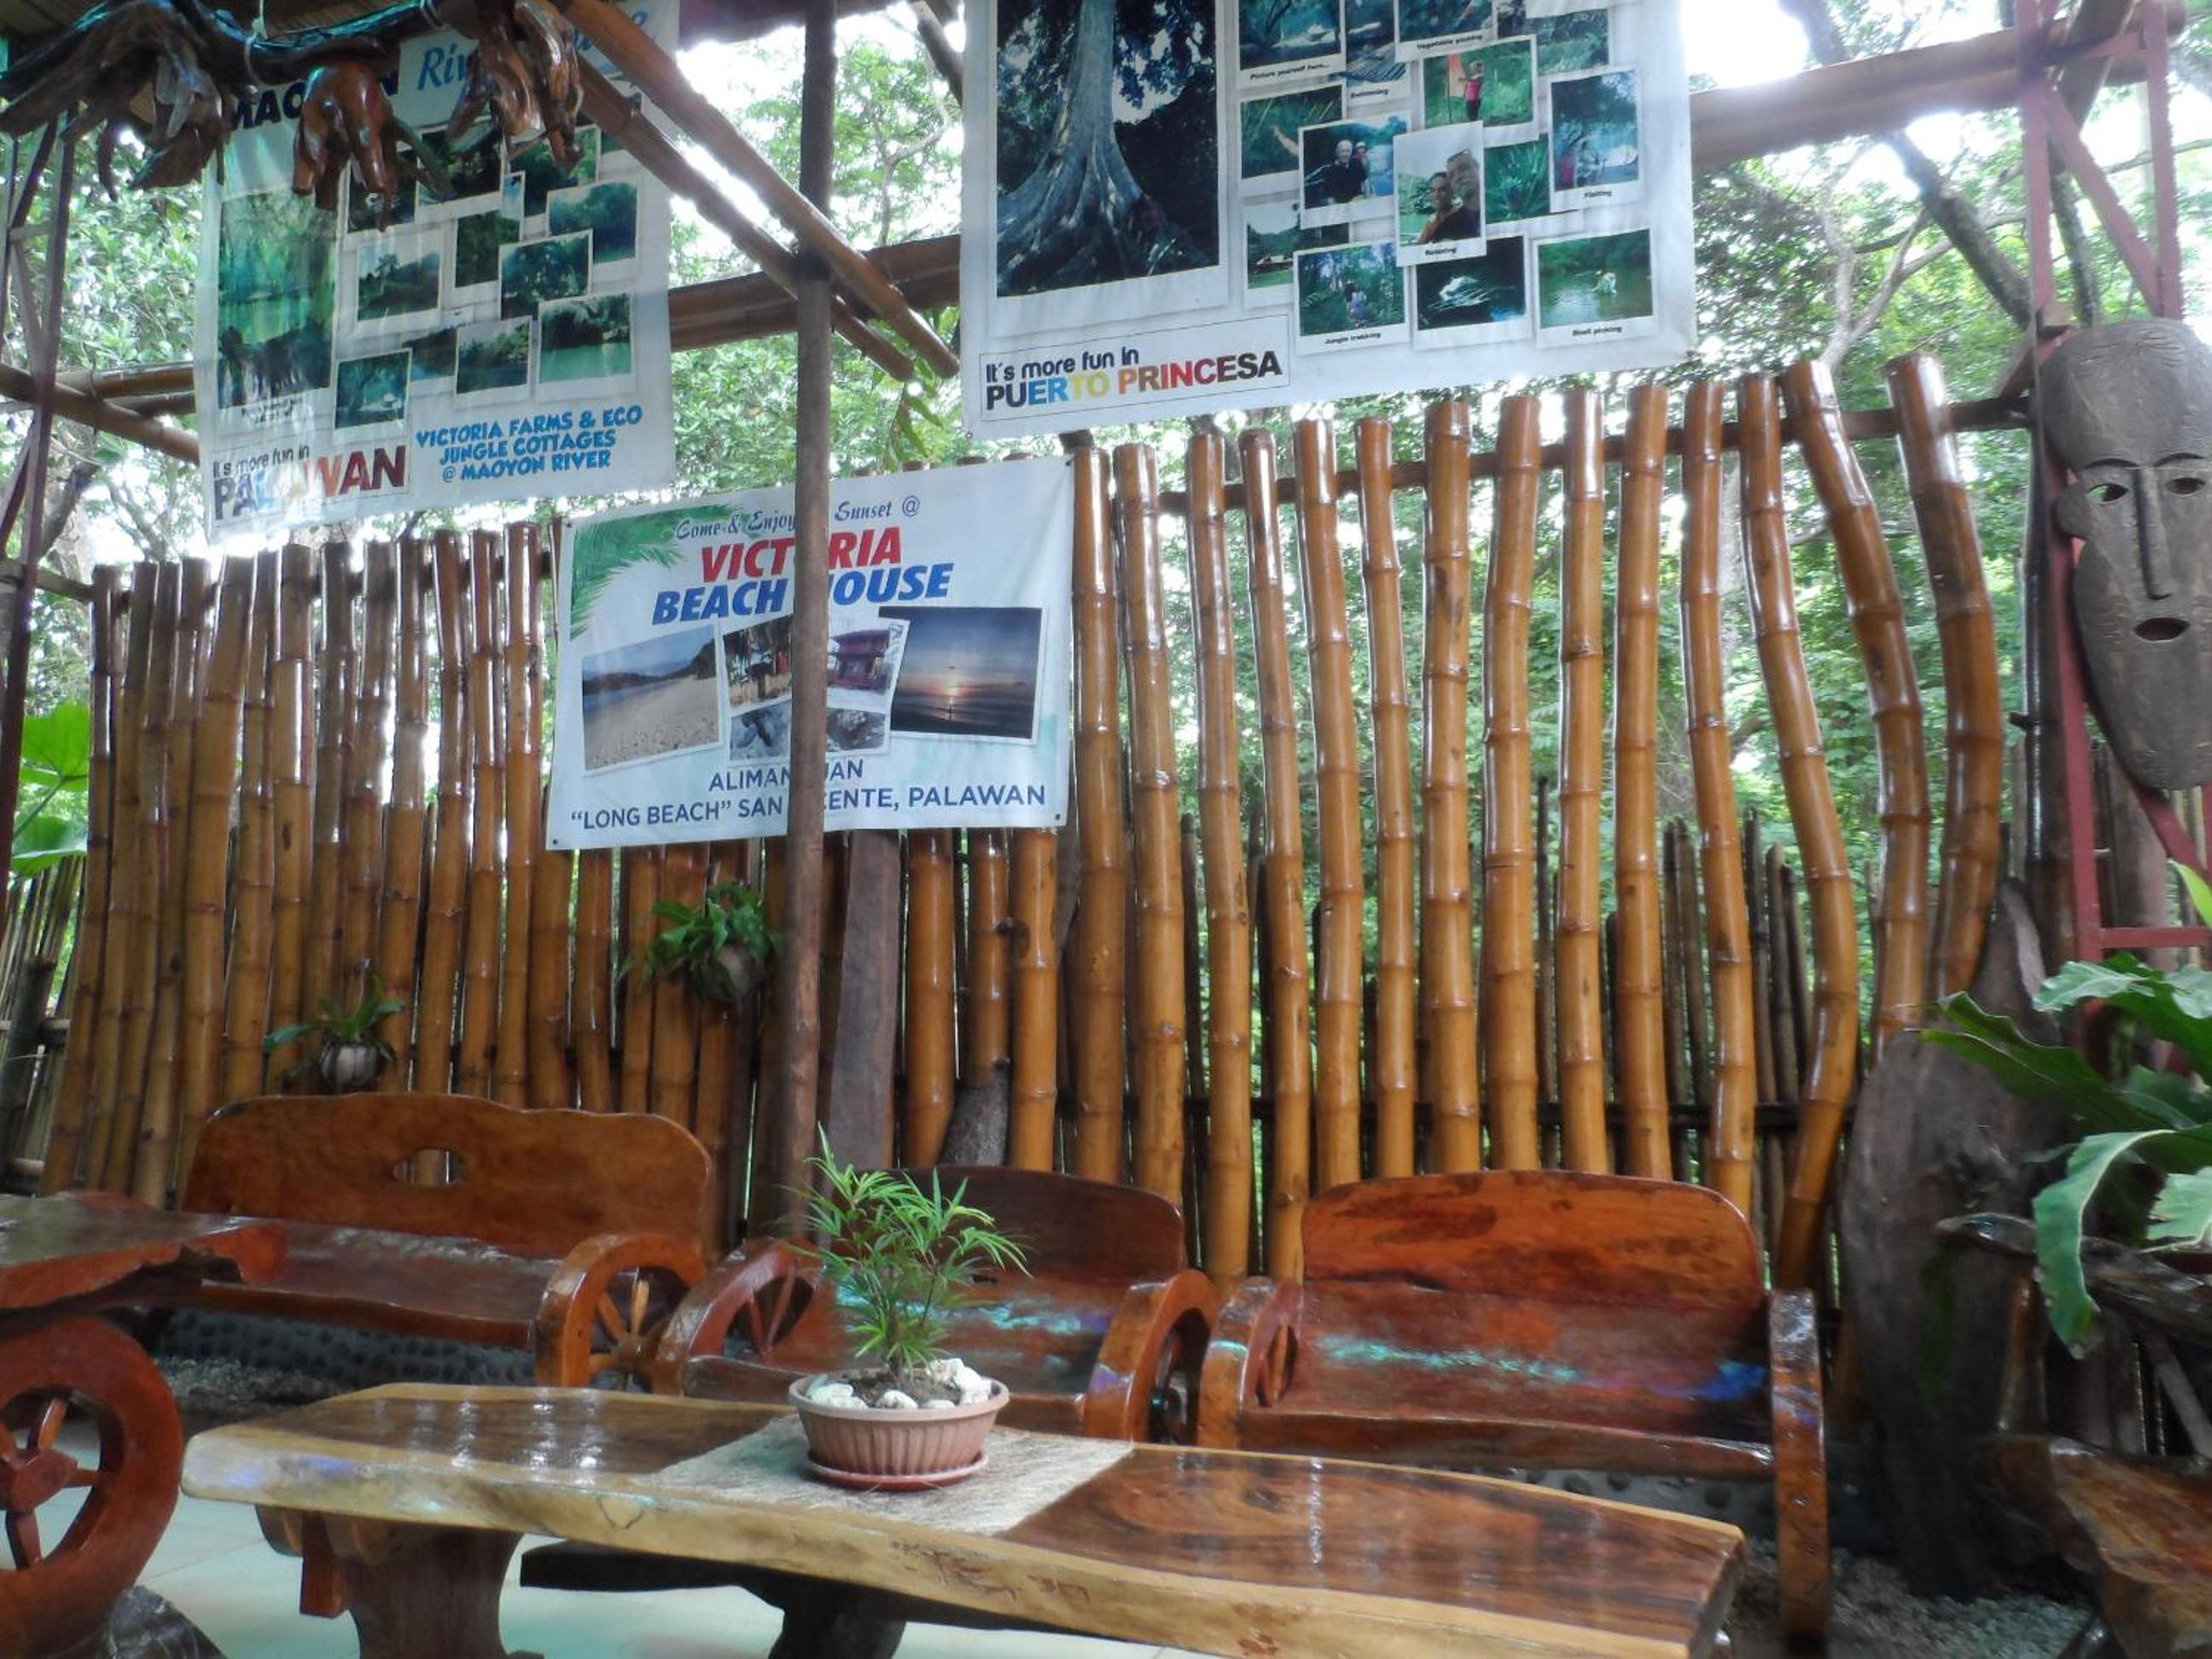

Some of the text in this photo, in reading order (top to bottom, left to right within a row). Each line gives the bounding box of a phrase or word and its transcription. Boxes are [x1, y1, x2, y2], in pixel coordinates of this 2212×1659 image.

[986, 351, 1284, 410] PUERTO PRINCESA
[1022, 356, 1076, 381] more
[1081, 350, 1115, 371] fun
[1121, 345, 1140, 367] in
[416, 405, 643, 449] VICTORIA FARMS & ECO
[439, 428, 617, 466] JUNGLE COTTAGES
[212, 461, 232, 479] Its
[236, 453, 270, 475] more
[214, 445, 407, 521] PALWAN
[441, 449, 612, 483] @ MAOYON RIVER
[676, 494, 921, 540] Come & Enjoy Sunset @
[701, 526, 902, 584] VICTRIA
[652, 563, 955, 626] BEACH OUSE
[709, 758, 864, 792] ALIMANAN
[738, 795, 783, 818] SAN
[908, 783, 1046, 807] PALAWAN
